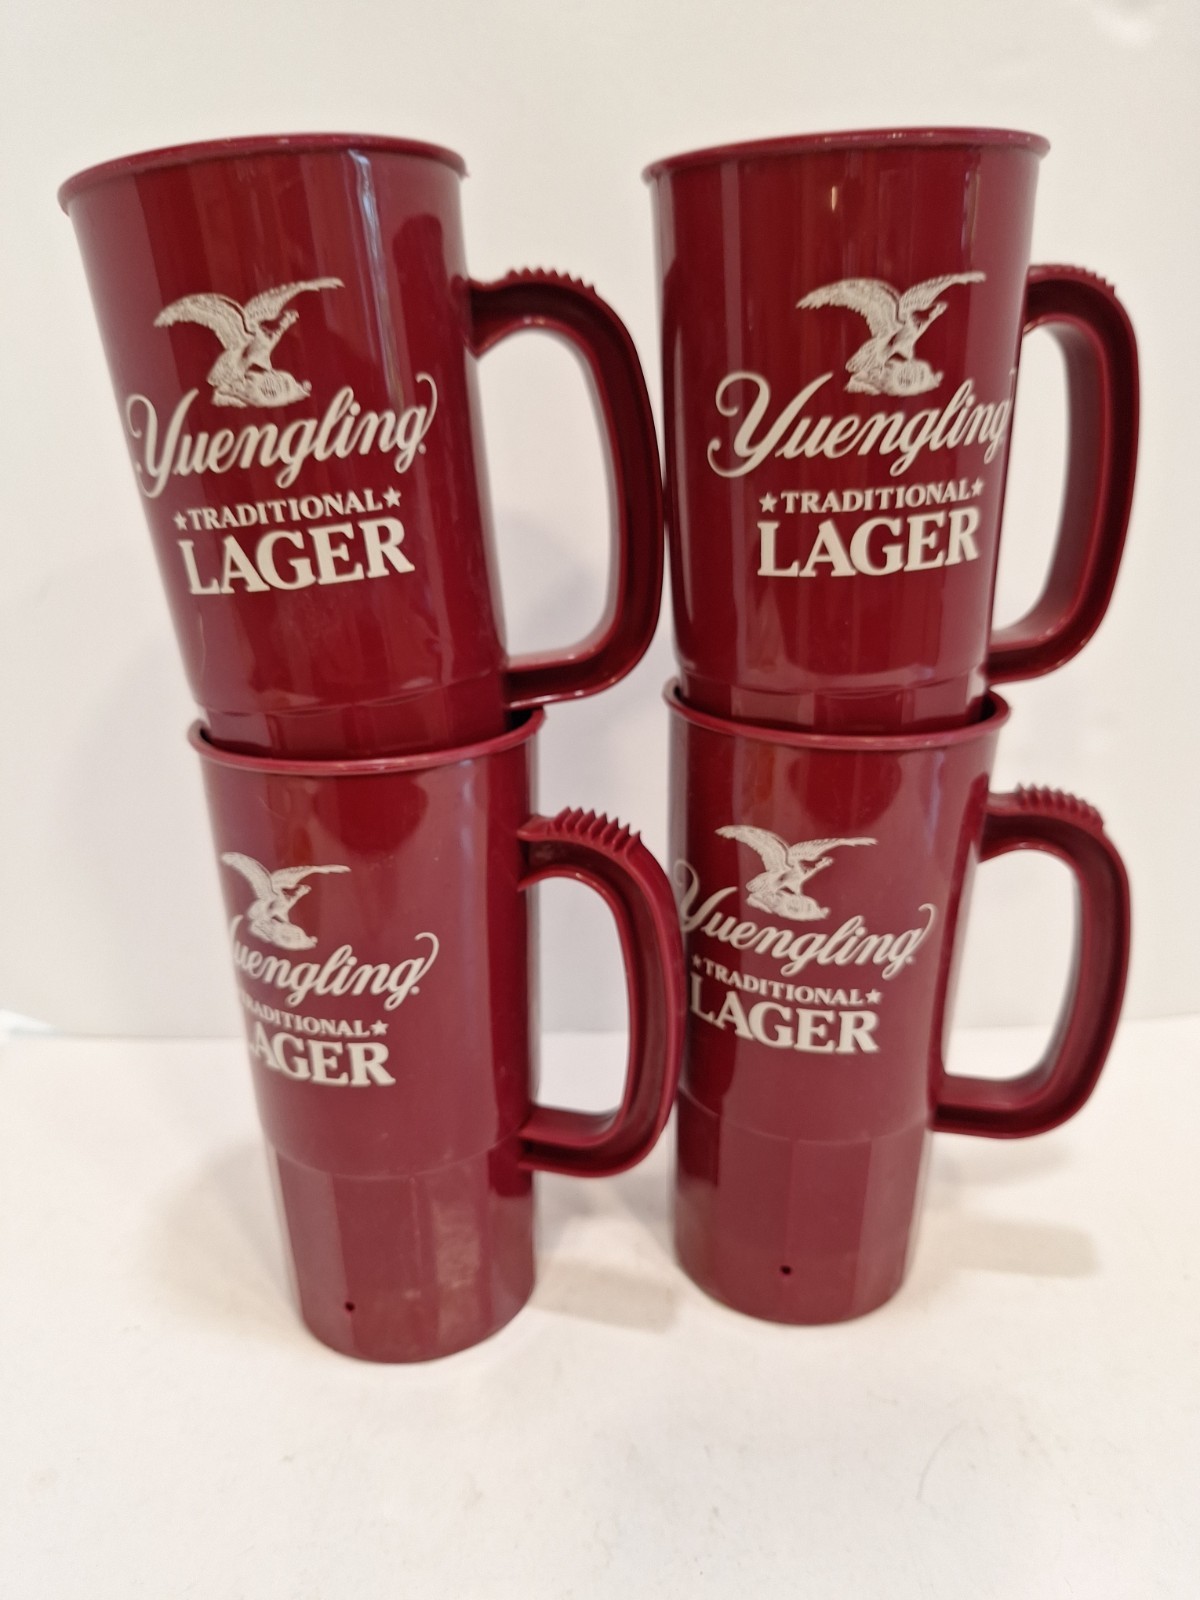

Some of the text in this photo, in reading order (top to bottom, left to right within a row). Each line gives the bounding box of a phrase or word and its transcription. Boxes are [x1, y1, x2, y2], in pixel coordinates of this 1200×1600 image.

[187, 488, 383, 531] TRADITIONAL
[781, 479, 971, 514] TRADITIONAL
[177, 517, 415, 595] LAGER
[757, 506, 980, 578] LAGER
[690, 972, 880, 1054] LAGER
[703, 957, 864, 1007] TRADITIONAL
[248, 1020, 397, 1087] AGER
